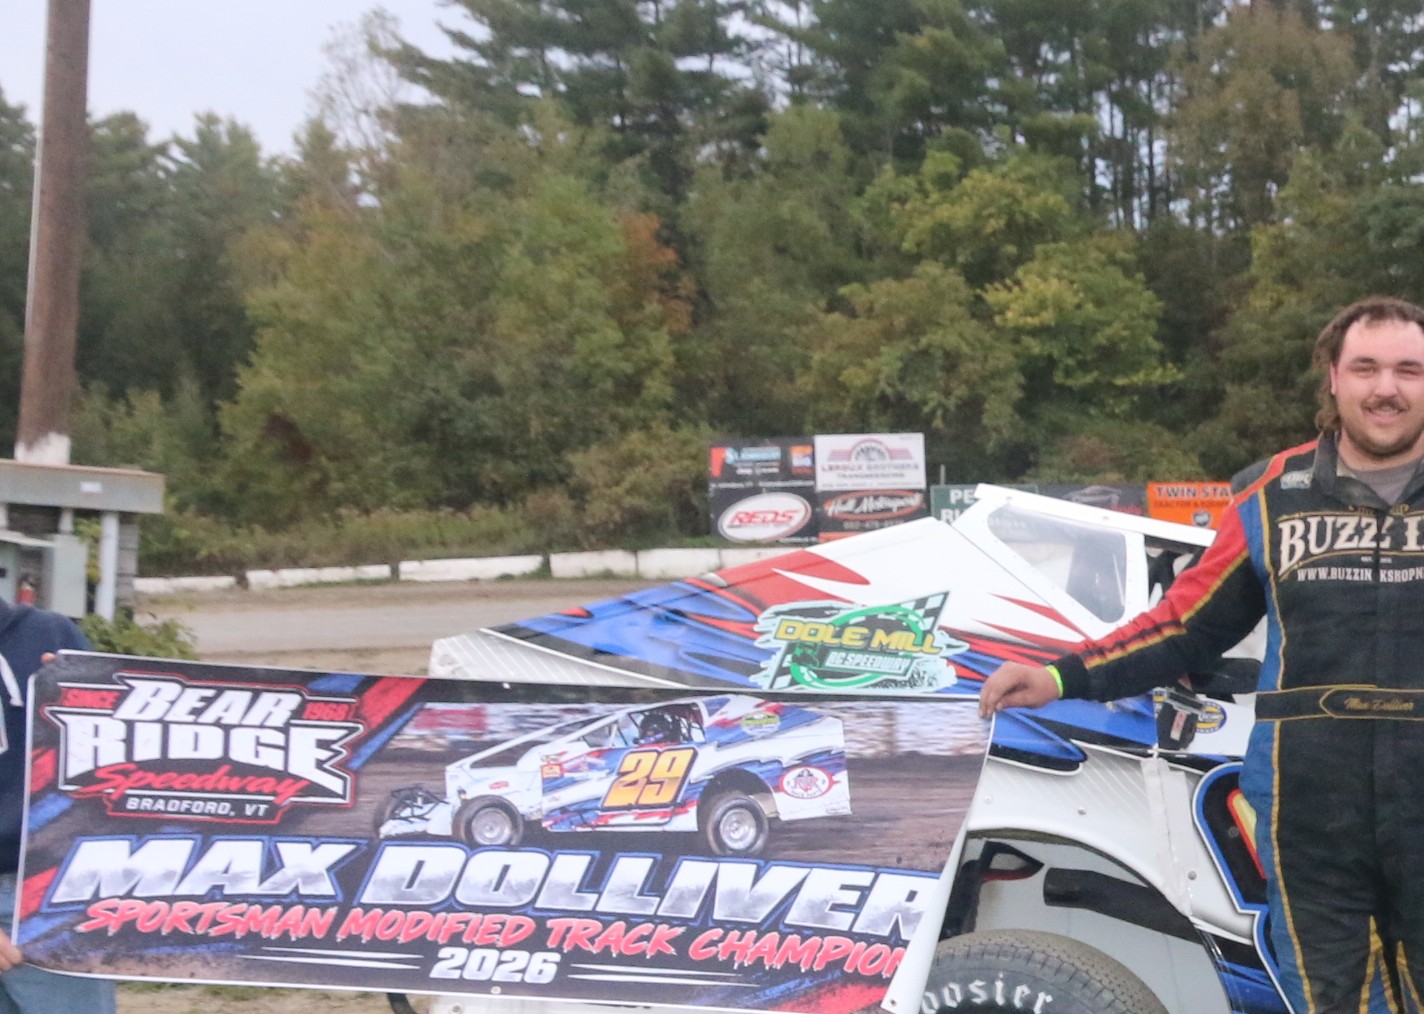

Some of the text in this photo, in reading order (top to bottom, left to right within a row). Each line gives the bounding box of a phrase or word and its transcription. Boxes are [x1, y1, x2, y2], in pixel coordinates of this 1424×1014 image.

[1155, 486, 1231, 497] TWIN STA
[775, 619, 943, 655] DOLE MILL
[113, 675, 306, 727] BEAR
[46, 707, 363, 796] RIDGE
[73, 762, 311, 801] Speedway
[602, 746, 699, 810] 29
[126, 797, 270, 818] BRADFORD, VT
[48, 836, 940, 943] MAX DOLLIVER
[75, 899, 338, 941] SPORTSMAN
[337, 909, 533, 946] MODIFIED
[546, 918, 687, 957] TRACK
[429, 947, 562, 985] 2026
